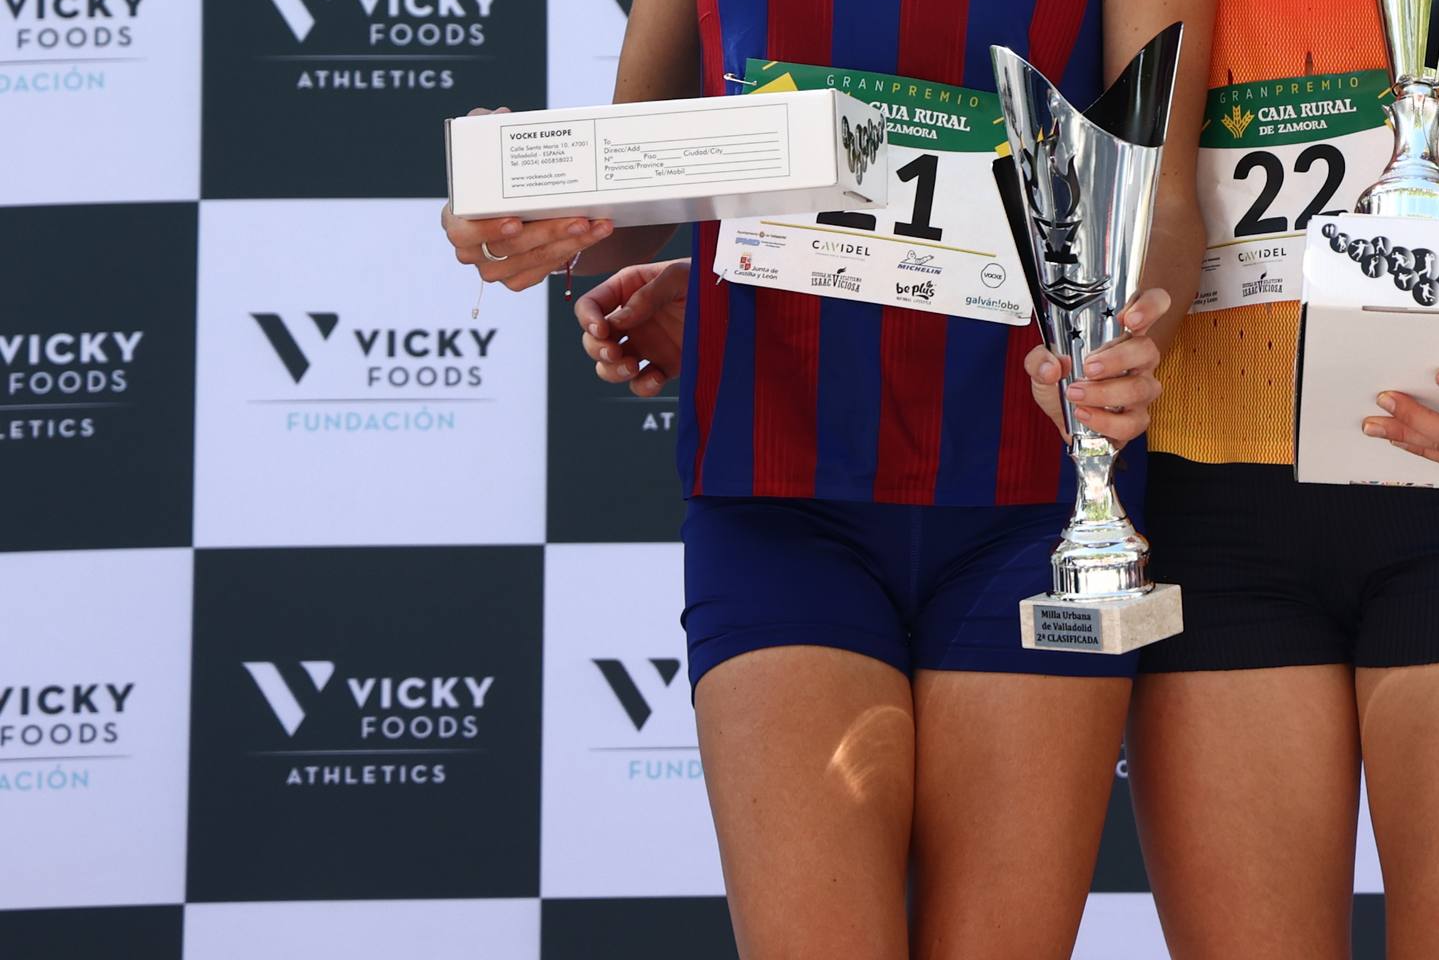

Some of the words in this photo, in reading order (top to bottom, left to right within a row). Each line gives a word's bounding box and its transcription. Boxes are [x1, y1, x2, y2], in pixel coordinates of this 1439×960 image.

[17, 26, 132, 49] FOODS
[370, 24, 484, 45] FOODS
[0, 67, 105, 92] DACIÓN
[298, 70, 453, 88] ATHLETICS
[913, 108, 971, 132] RURAL
[1258, 104, 1297, 122] CAJA
[1301, 98, 1357, 118] RURAL
[510, 131, 537, 140] VOCKE
[540, 129, 572, 138] EUROPE
[886, 122, 938, 139] ZAMORA
[1259, 126, 1274, 136] DE
[1278, 120, 1328, 133] ZAMORA
[1233, 143, 1349, 238] 22
[812, 240, 871, 257] CAVIDEL
[1238, 247, 1287, 262] CAVIDEL
[897, 263, 942, 275] MICHELIN
[811, 277, 832, 287] ISAAC
[832, 273, 860, 293] VICIOSA
[896, 282, 910, 294] be
[912, 281, 935, 299] plus
[0, 332, 143, 365] VICKY
[355, 329, 496, 357] VICKY
[9, 370, 126, 394] FOODS
[368, 366, 482, 387] FOODS
[0, 418, 95, 439] ETICS
[286, 408, 456, 431] FUNDACIÓN
[1041, 610, 1061, 619] Milla
[1062, 611, 1091, 620] Urbana
[1042, 622, 1051, 630] de
[1053, 622, 1092, 632] Valladolid
[1047, 634, 1099, 645] CLASIFICADA
[0, 683, 136, 715] VICKY
[348, 677, 493, 708] VICKY
[0, 723, 118, 747] FOODS
[362, 716, 477, 738] FOODS
[0, 765, 90, 792] ACIÓN
[287, 765, 445, 784] ATHLETICS
